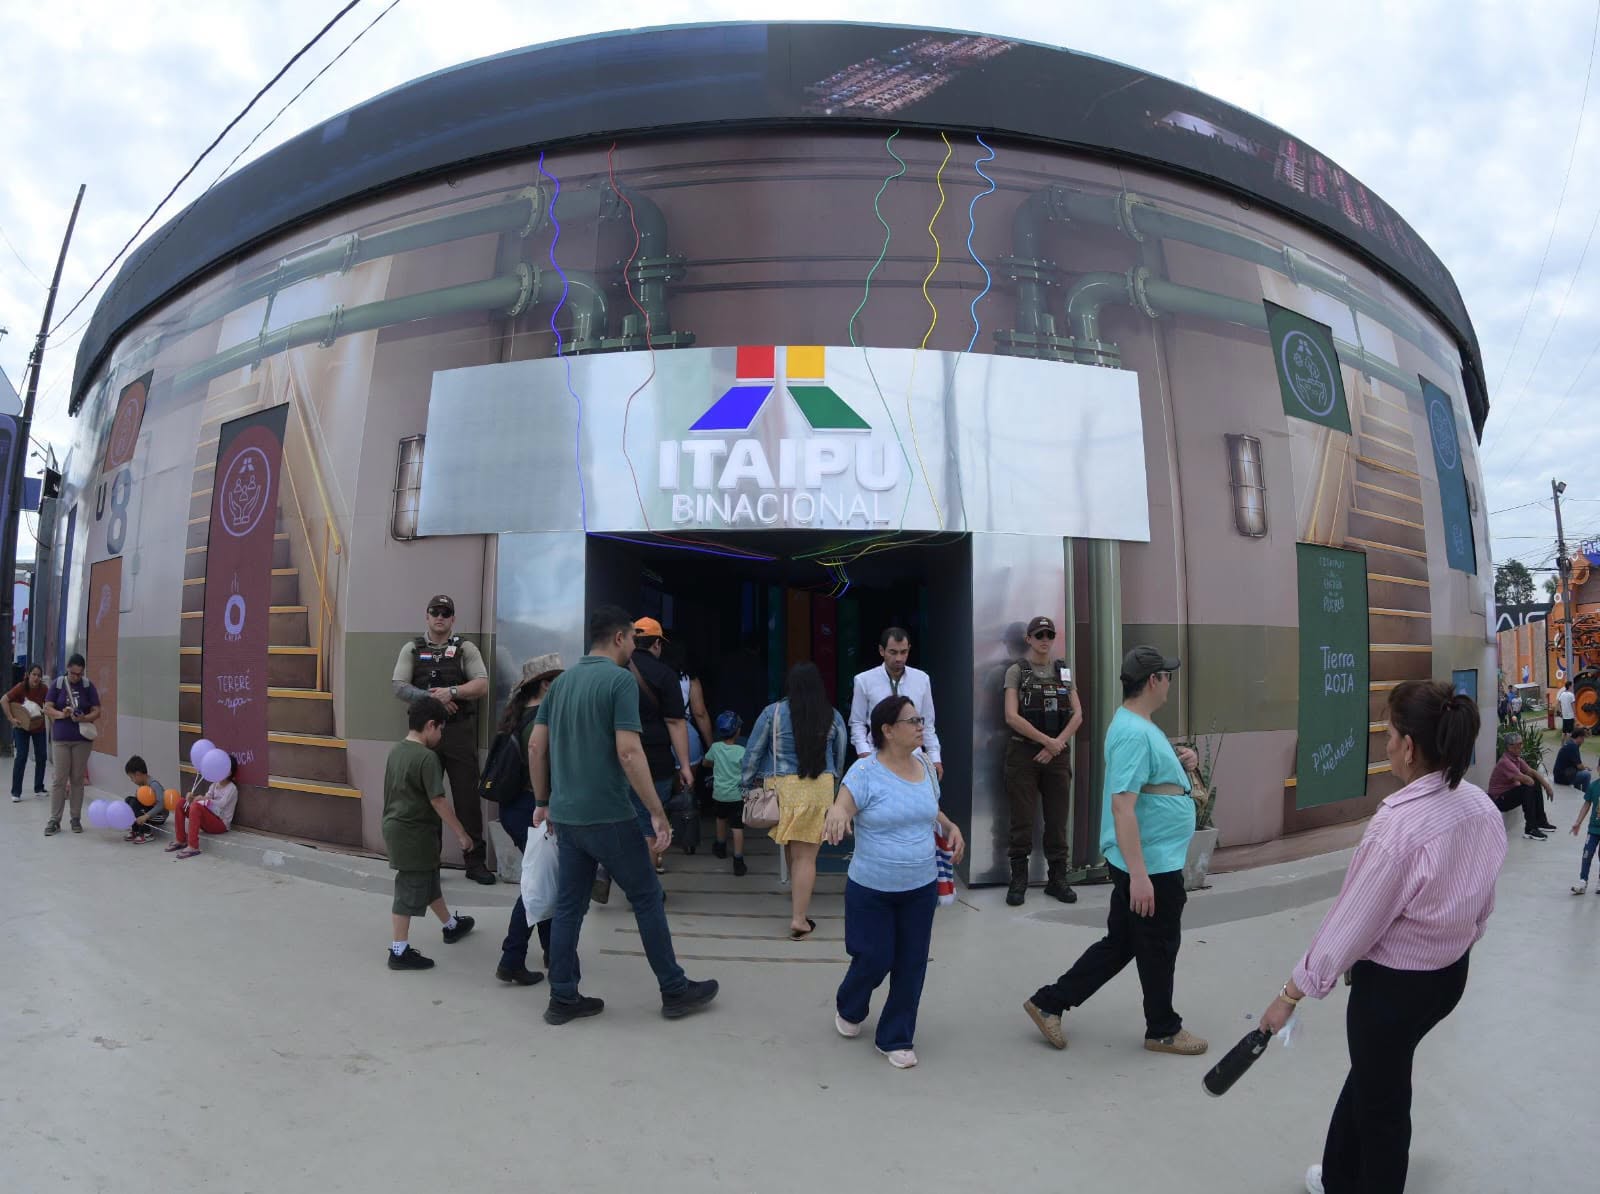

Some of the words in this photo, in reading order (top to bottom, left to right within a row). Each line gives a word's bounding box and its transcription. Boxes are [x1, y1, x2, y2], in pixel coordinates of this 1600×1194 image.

[658, 438, 898, 491] ITAIPU
[671, 492, 891, 525] BINACIONAL
[1320, 646, 1355, 670] Tierra
[1324, 673, 1354, 696] ROJA
